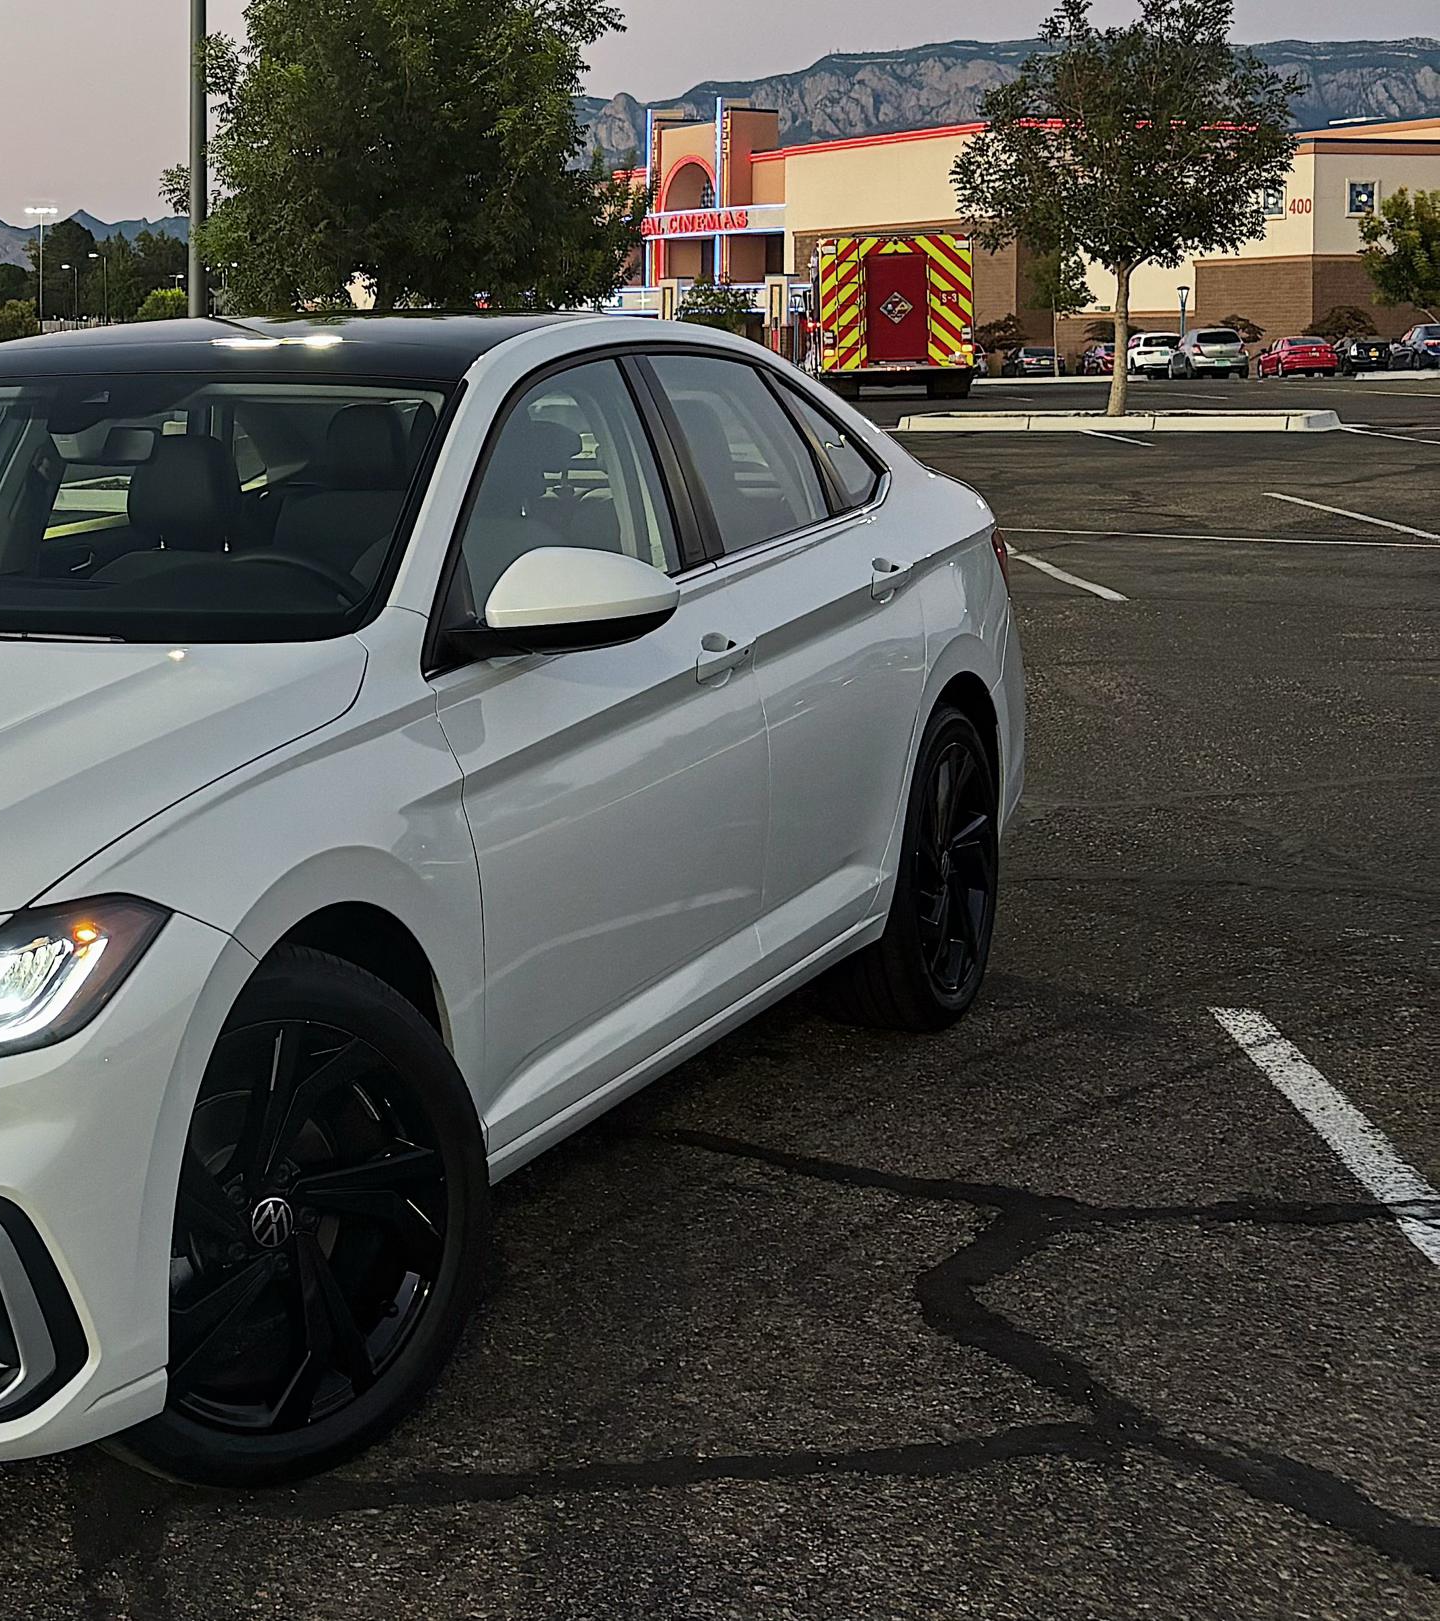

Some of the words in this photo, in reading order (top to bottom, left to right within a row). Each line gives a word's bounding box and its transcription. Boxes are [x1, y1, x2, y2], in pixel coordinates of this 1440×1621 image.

[1289, 198, 1312, 214] 400
[668, 210, 748, 234] CINEMAS
[942, 293, 957, 303] S-3
